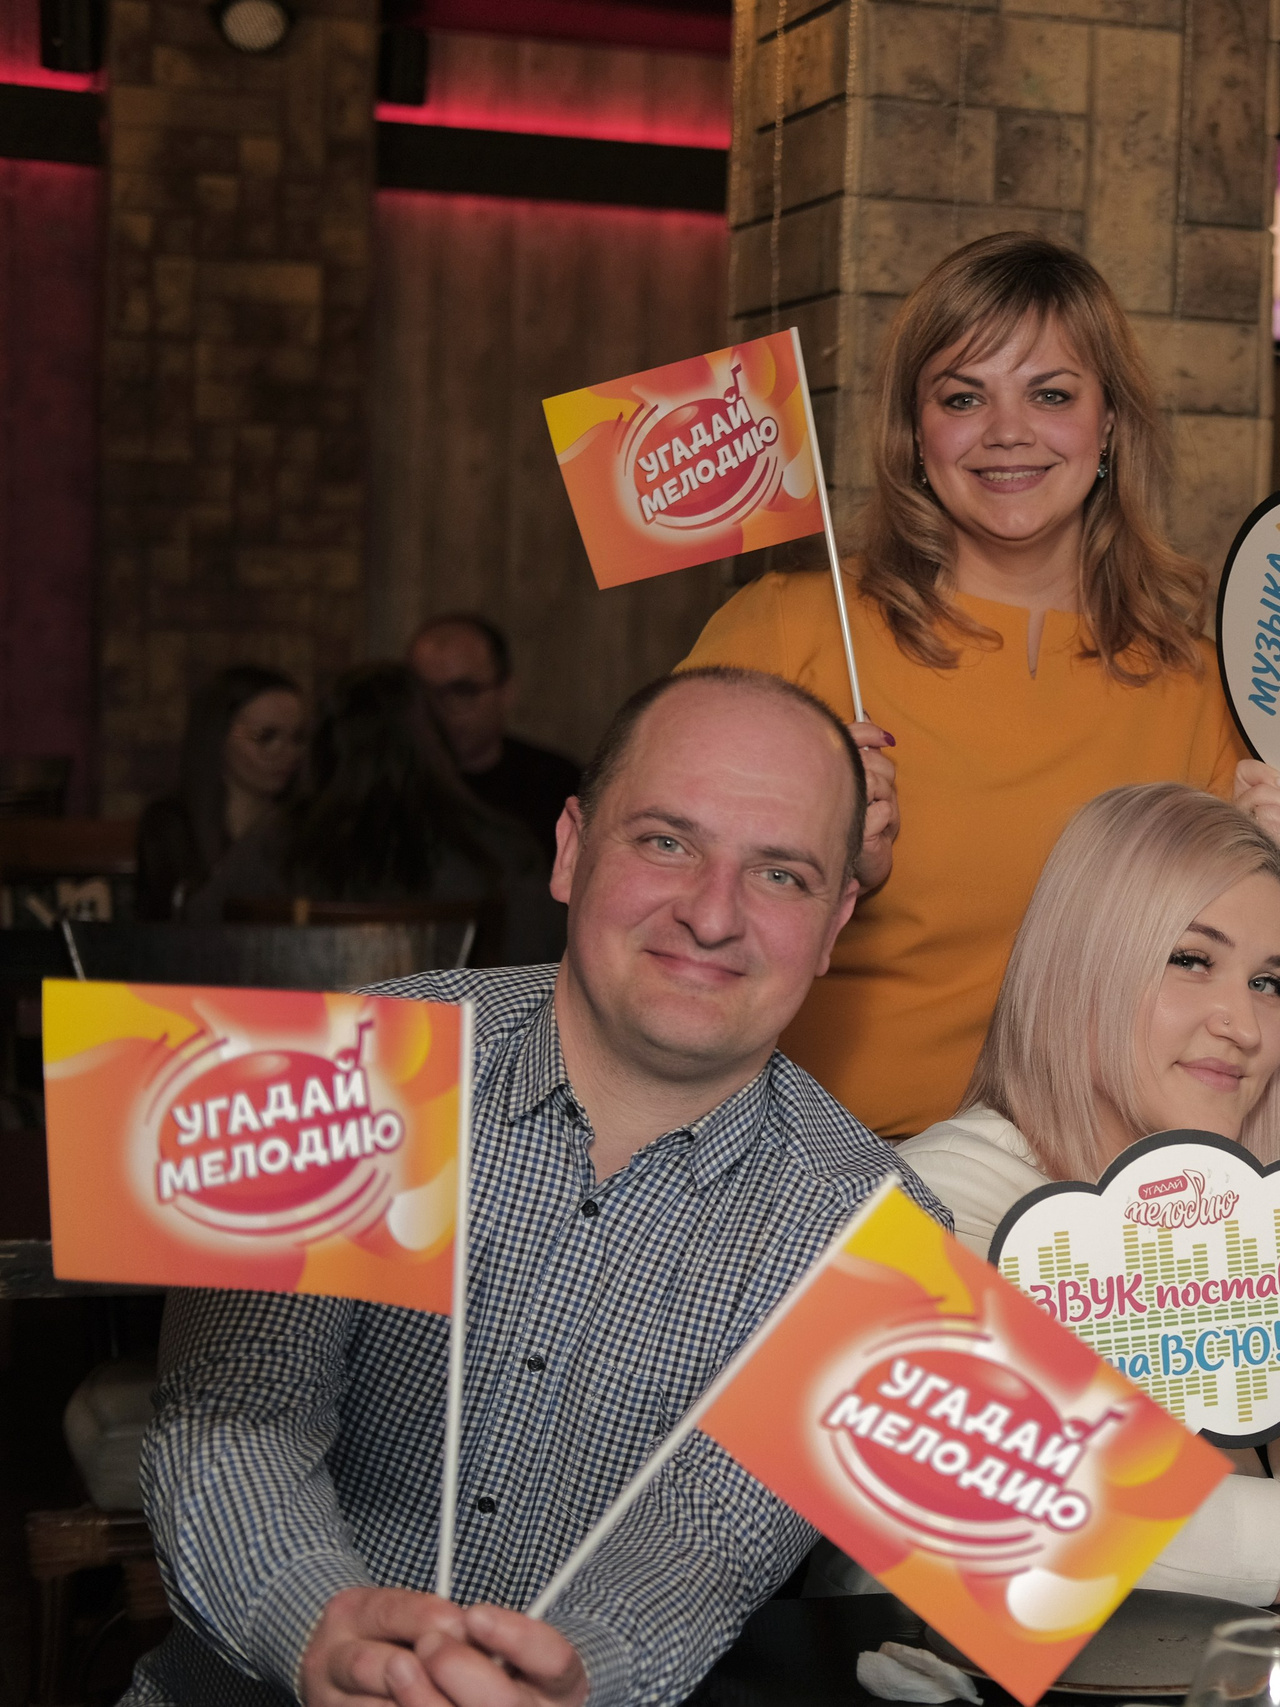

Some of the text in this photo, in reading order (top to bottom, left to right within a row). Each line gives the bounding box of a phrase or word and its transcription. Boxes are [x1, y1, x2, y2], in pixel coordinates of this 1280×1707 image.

[637, 396, 752, 483] УГАДАЙ
[640, 417, 778, 521] МЕЛОДИЮ
[172, 1055, 367, 1146] УГАДАЙ
[159, 1113, 402, 1200] МЕЛОДИЮ
[1142, 1178, 1184, 1199] УГАДАЙ
[1030, 1274, 1147, 1322] ЗВУК
[828, 1395, 1087, 1529] МЕЛОДИЮ
[879, 1360, 1086, 1475] УГАДАЙ
